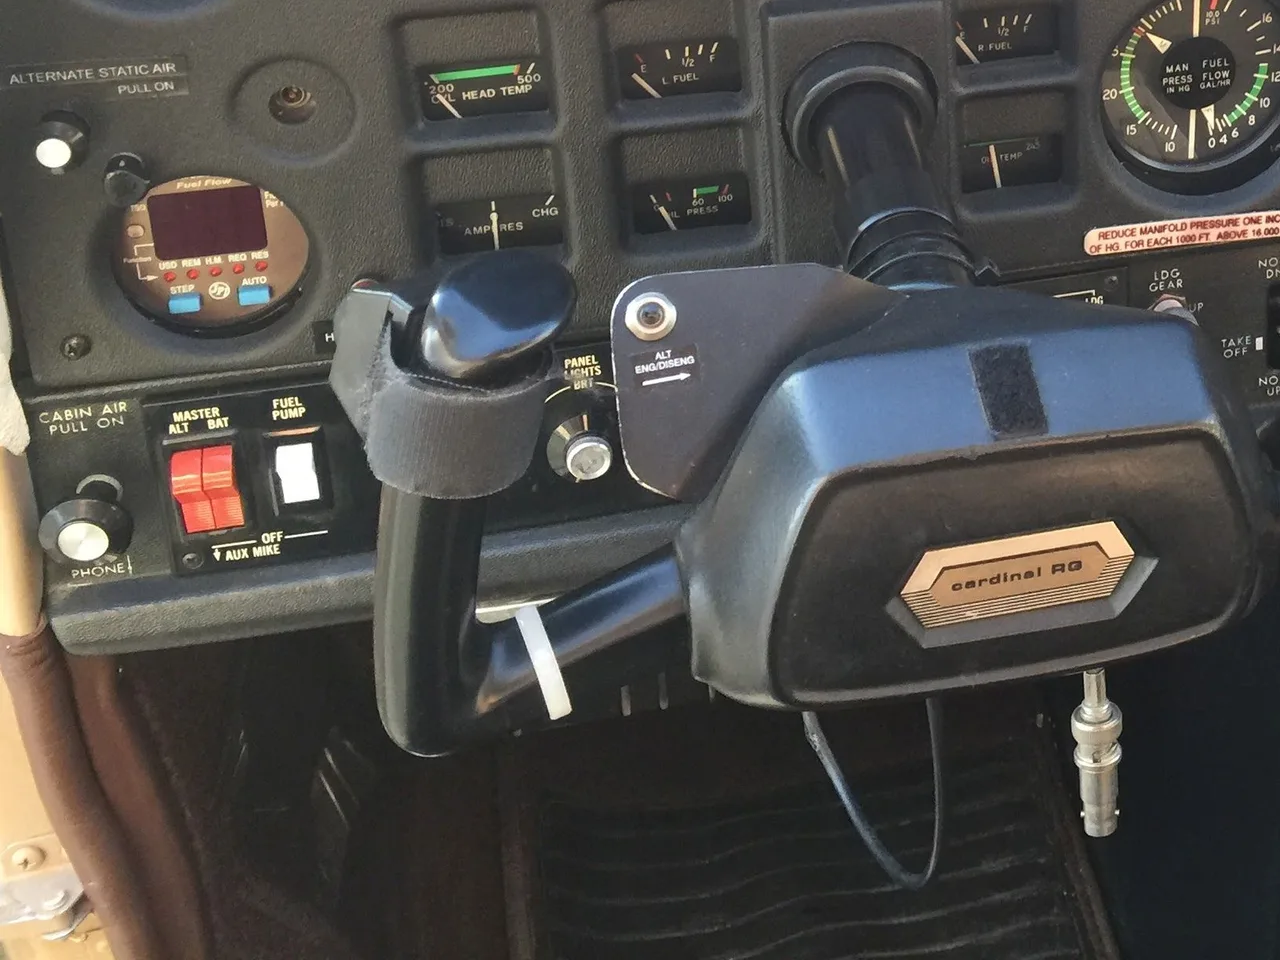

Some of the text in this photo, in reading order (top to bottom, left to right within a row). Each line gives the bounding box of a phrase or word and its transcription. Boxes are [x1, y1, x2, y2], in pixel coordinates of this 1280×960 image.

[1203, 58, 1229, 68] FUEL
[10, 62, 176, 85] ALTERNATE STATIC AIR
[673, 73, 699, 83] FUEL
[1202, 70, 1230, 80] FLOW
[118, 81, 174, 95] PULL ON
[1200, 79, 1230, 89] GAL/HR
[462, 84, 532, 100] HEAD TEMP
[176, 178, 232, 189] Fuel Flow
[532, 207, 559, 218] CHG
[687, 205, 718, 216] PRESS
[1098, 227, 1137, 241] REDUCE
[1139, 222, 1187, 236] MANIFOLD
[1190, 218, 1240, 230] PRESSURE
[1243, 216, 1263, 226] ONE
[242, 276, 267, 285] AUTO
[1154, 269, 1181, 281] LDG
[170, 284, 195, 294] STEP
[1149, 280, 1183, 292] GEAR
[1222, 336, 1251, 348] TAKE
[656, 350, 671, 361] ALT
[1224, 348, 1248, 359] OFF
[564, 354, 599, 368] PANEL
[635, 356, 695, 374] ENG/DISENG
[564, 365, 601, 379] LIGHTS
[272, 396, 302, 409] FUEL
[39, 401, 127, 424] CABIN AIR
[172, 408, 220, 422] MASTER
[272, 408, 306, 420] PUMP
[49, 416, 124, 436] PULL ON
[169, 417, 229, 434] ALT BAT
[261, 532, 283, 544] OFF
[226, 544, 281, 561] AUX MIKE
[71, 562, 125, 578] PHONE
[951, 560, 1083, 592] cardinal RG
